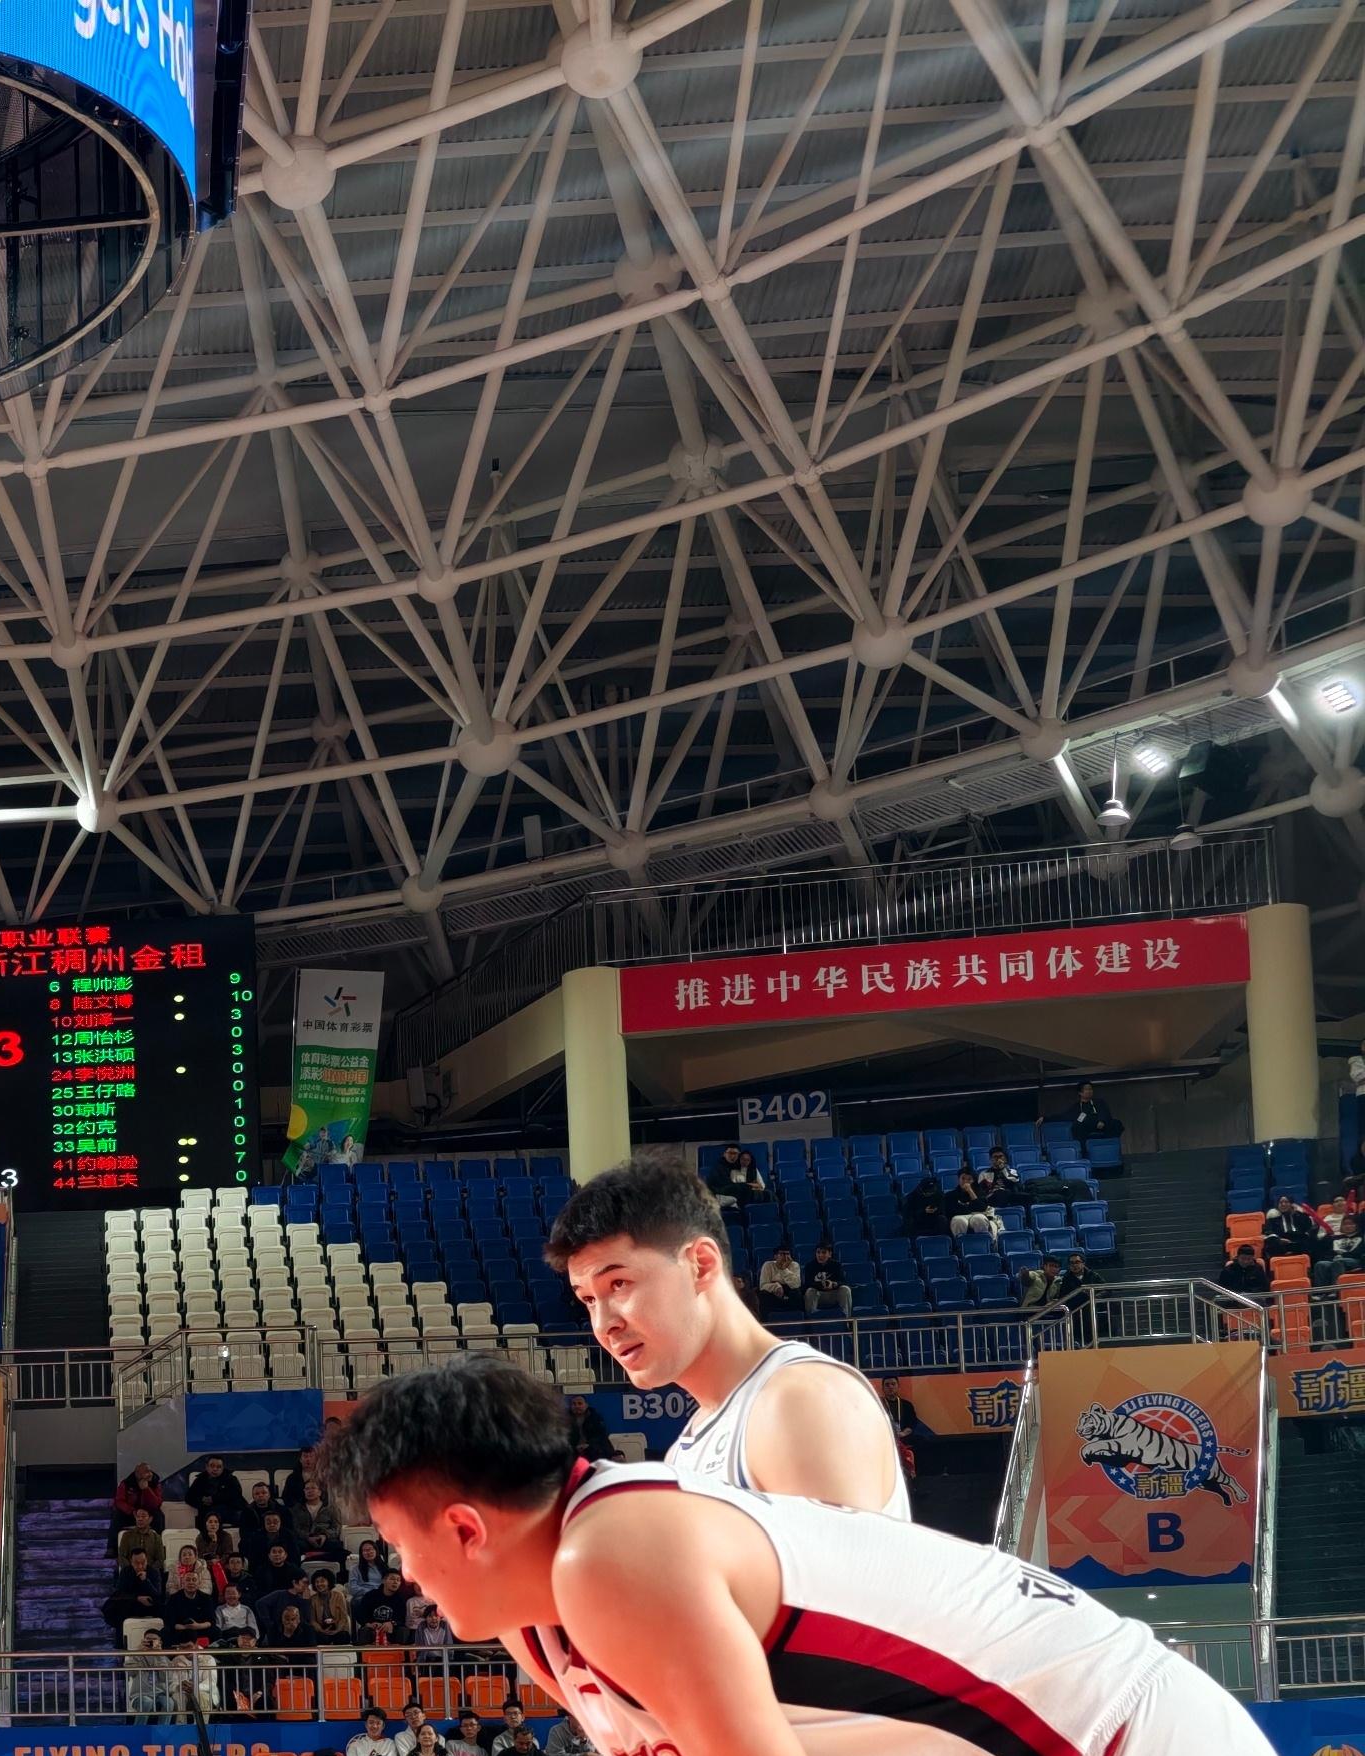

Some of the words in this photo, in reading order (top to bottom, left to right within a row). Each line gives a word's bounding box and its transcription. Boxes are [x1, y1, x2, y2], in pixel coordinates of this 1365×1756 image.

[675, 938, 1180, 1010] 推进中华民族共同体建设
[49, 981, 60, 992] 6
[230, 973, 240, 984] 9
[49, 999, 60, 1010] 8
[232, 990, 252, 1001] 10
[231, 1009, 241, 1020] 3
[231, 1026, 242, 1037] 0
[232, 1044, 242, 1056] 3
[233, 1062, 243, 1073] 0
[233, 1080, 244, 1091] 0
[235, 1098, 242, 1109] 1
[742, 1090, 829, 1125] B402
[234, 1116, 244, 1127] 0
[234, 1134, 245, 1145] 0
[235, 1152, 245, 1163] 7
[0, 1168, 19, 1187] 3
[235, 1170, 246, 1181] 0
[1137, 1394, 1179, 1408] FLYING
[1180, 1401, 1214, 1439] TIGERS
[1135, 1471, 1185, 1499] 新疆
[1146, 1512, 1185, 1553] B
